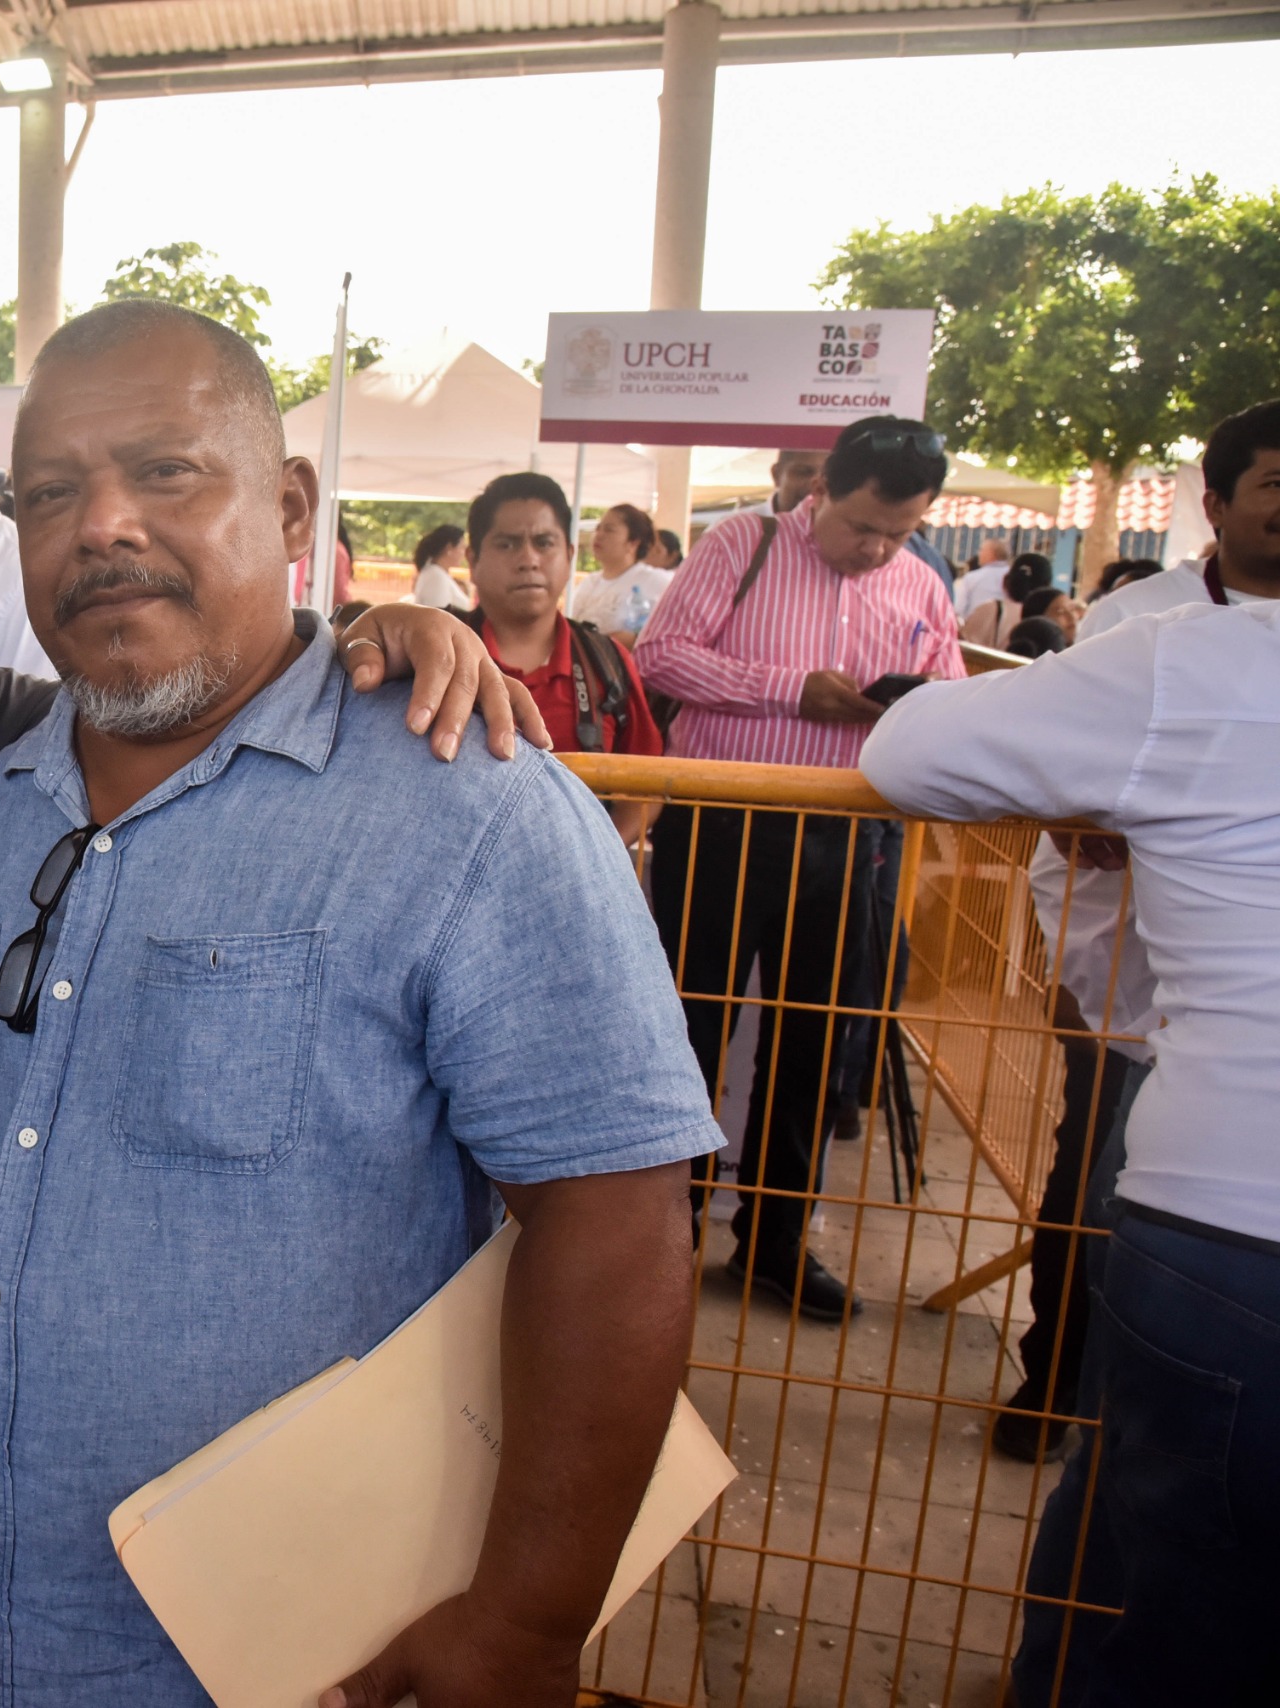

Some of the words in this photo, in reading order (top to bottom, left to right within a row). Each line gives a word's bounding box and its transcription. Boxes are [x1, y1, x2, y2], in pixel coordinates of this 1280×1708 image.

[822, 325, 846, 340] TA
[623, 342, 712, 367] UPCH
[819, 342, 859, 357] BAS
[817, 359, 845, 375] CO
[620, 371, 696, 382] UNIVERSIDAD
[697, 372, 749, 382] POPULAR
[619, 384, 633, 394] DE
[635, 384, 650, 394] LA
[652, 384, 720, 395] CHONTALPA
[799, 390, 891, 407] EDUCACIÓN
[575, 681, 590, 713] EOS
